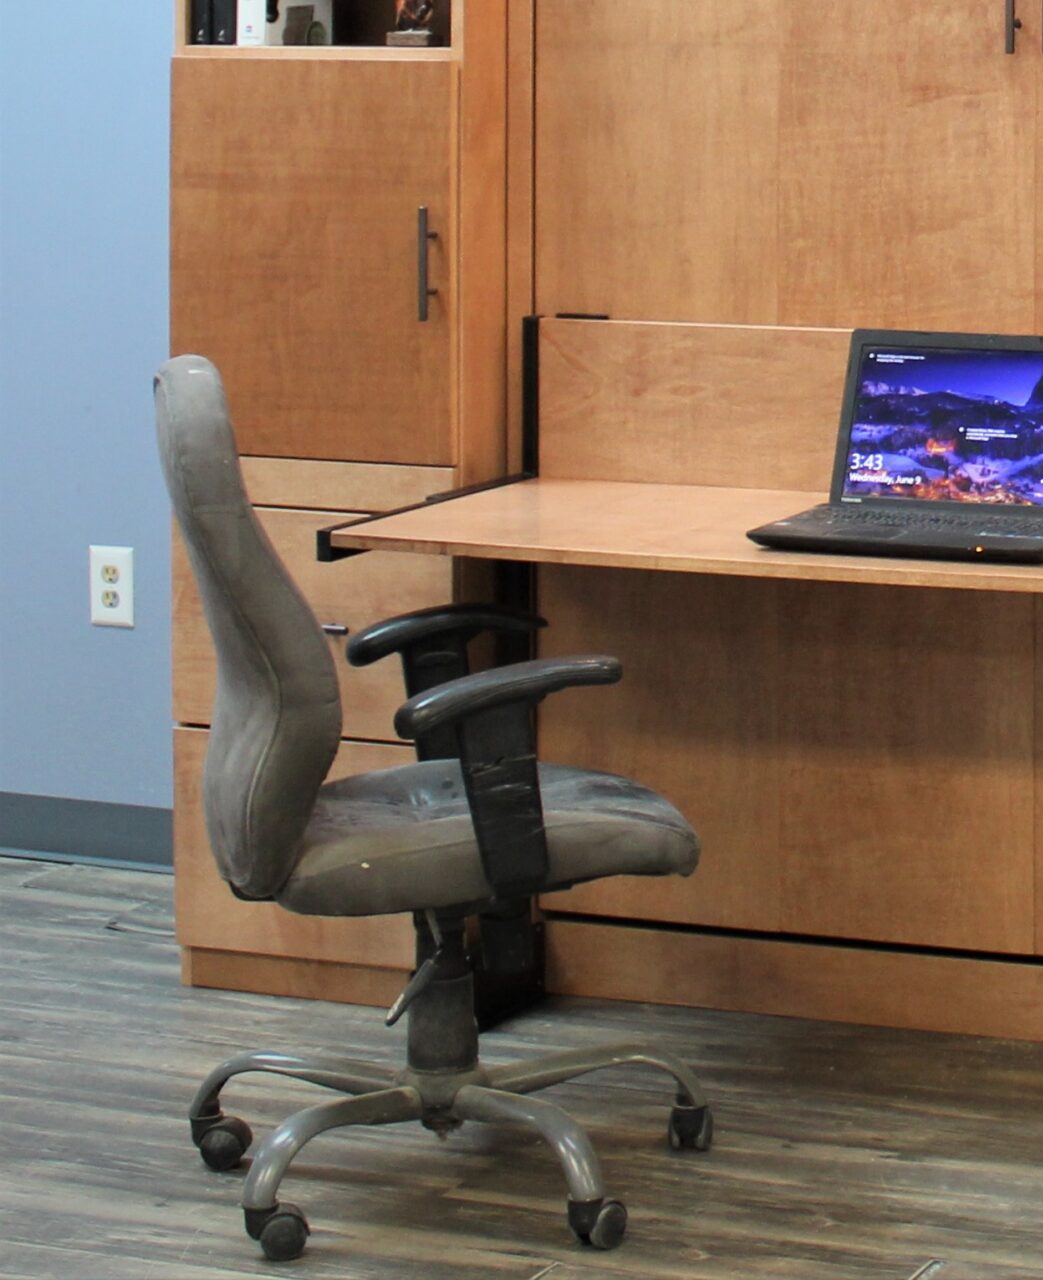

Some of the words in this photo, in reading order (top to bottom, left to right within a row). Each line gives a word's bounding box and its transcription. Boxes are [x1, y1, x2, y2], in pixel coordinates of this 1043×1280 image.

[850, 452, 884, 471] 3:43
[848, 472, 894, 485] Wednesday,
[895, 475, 914, 485] June
[915, 475, 922, 485] 9
